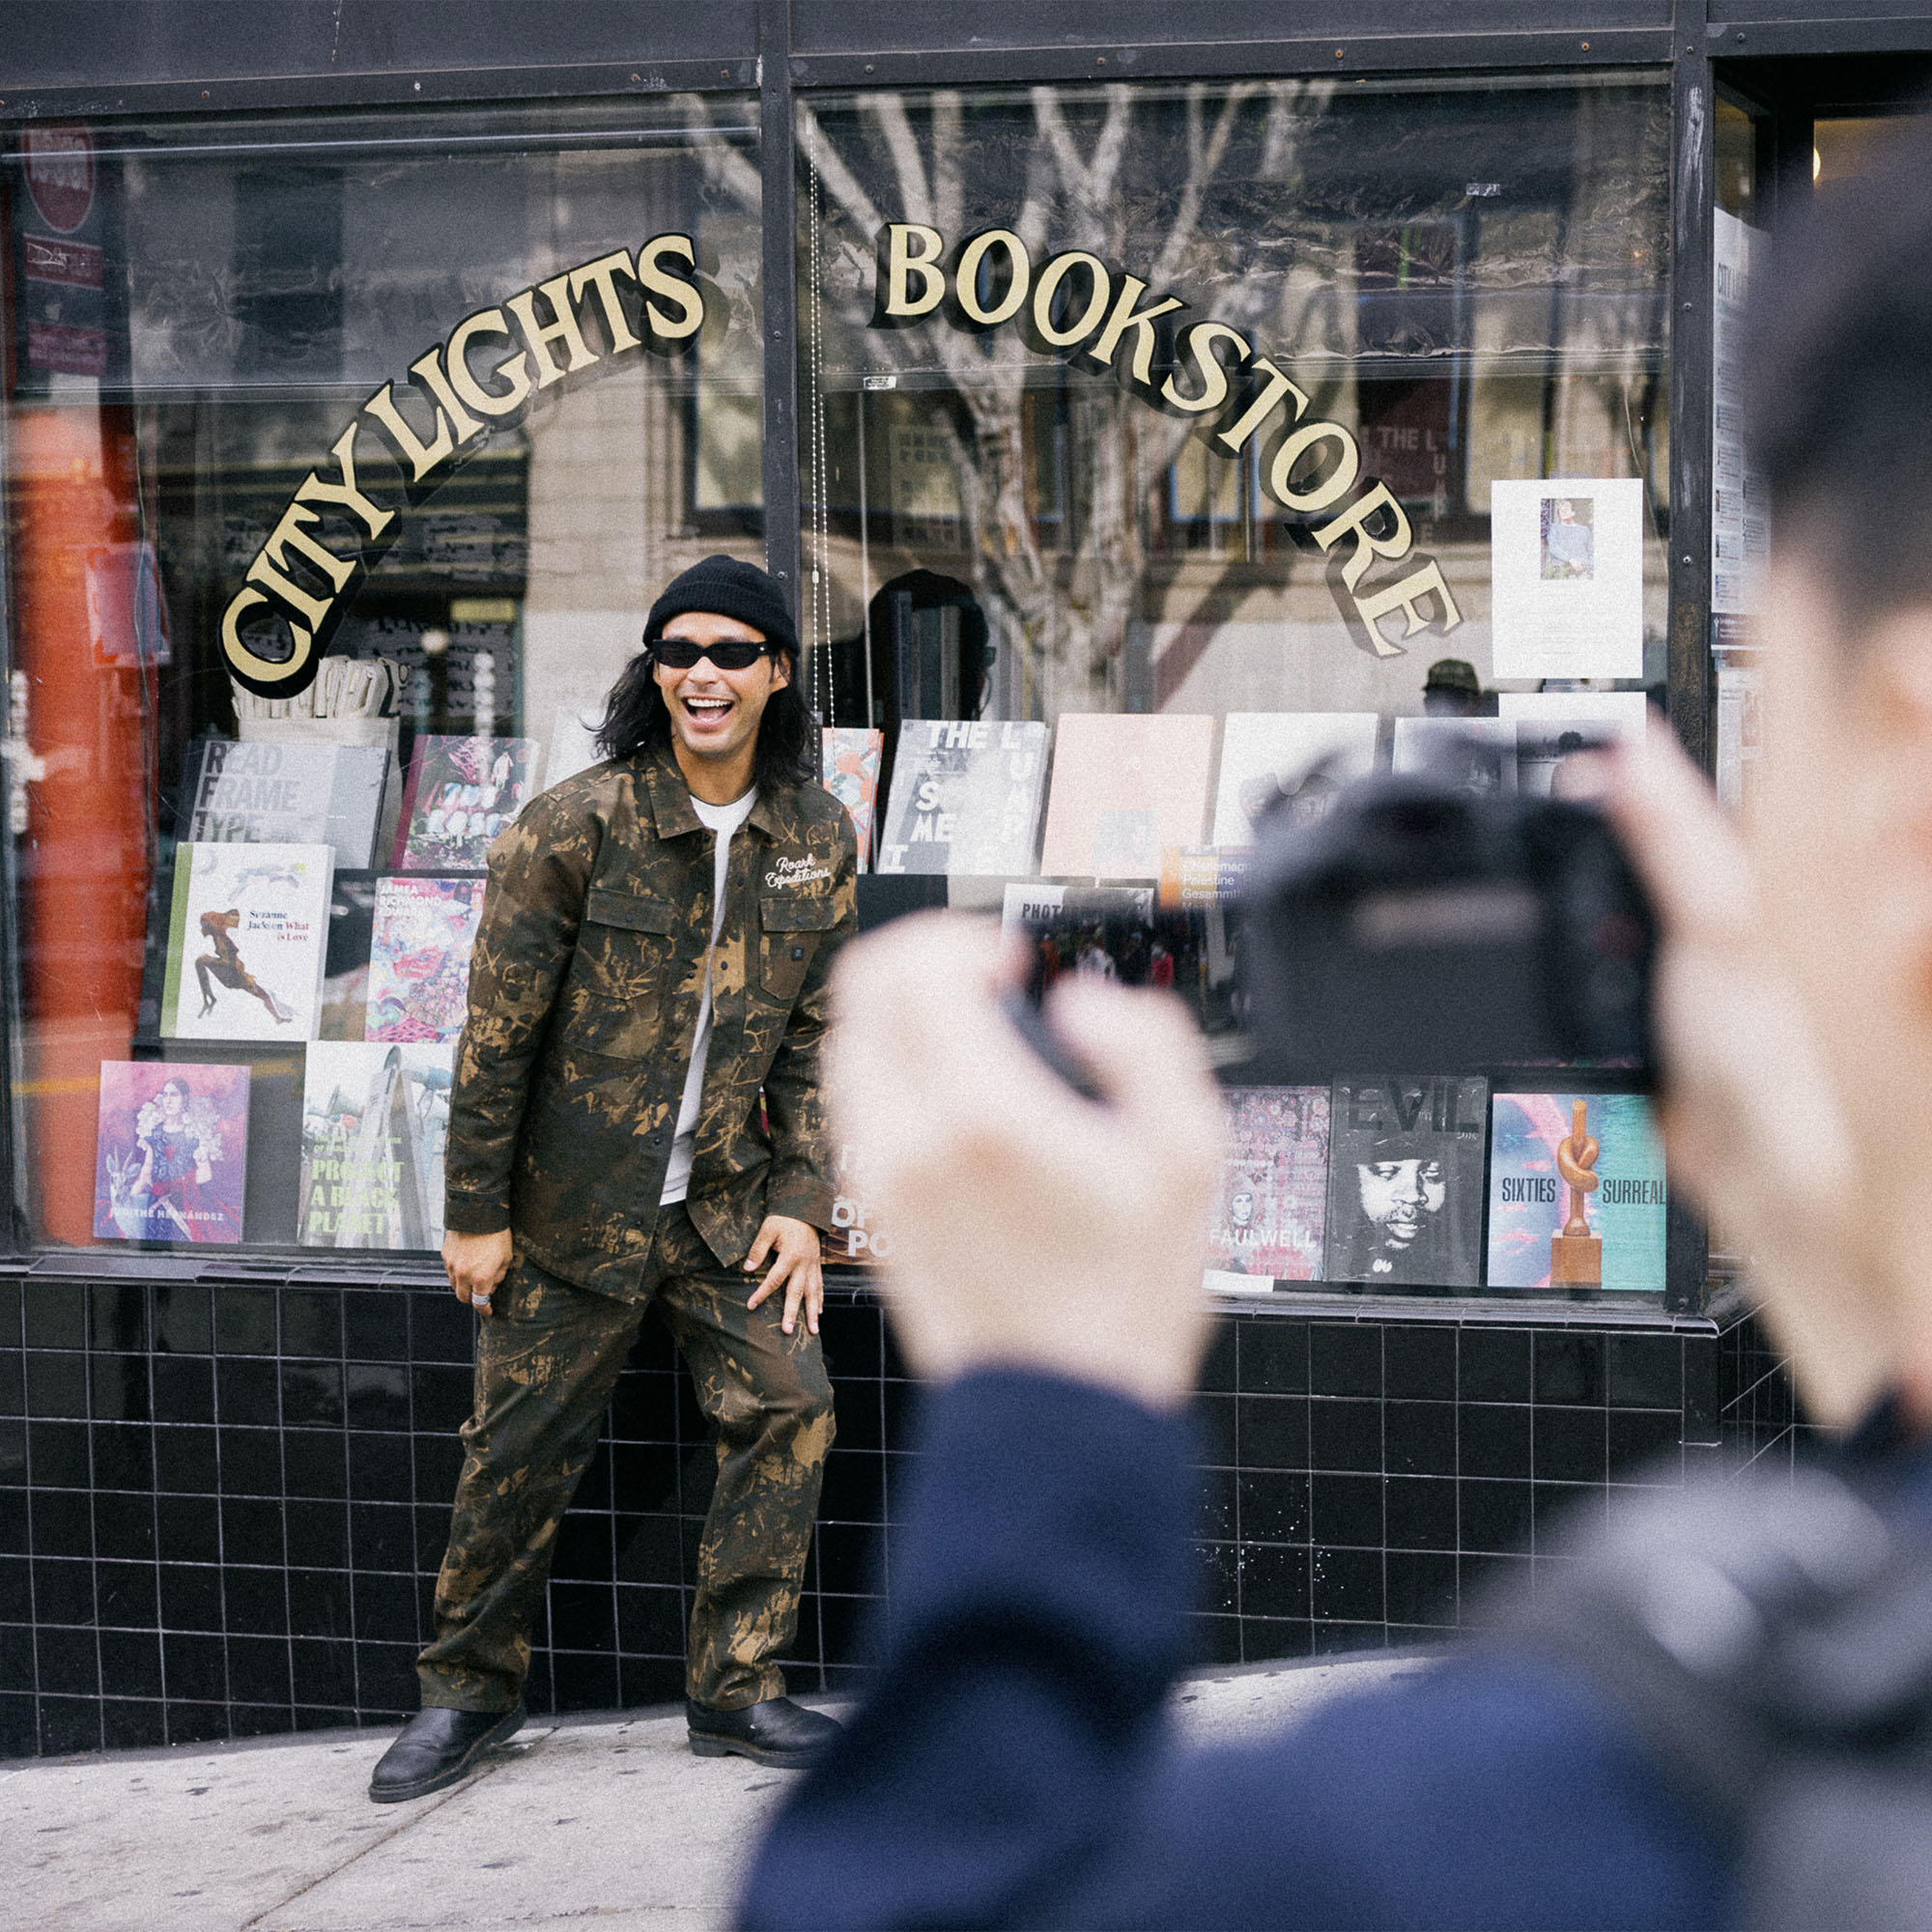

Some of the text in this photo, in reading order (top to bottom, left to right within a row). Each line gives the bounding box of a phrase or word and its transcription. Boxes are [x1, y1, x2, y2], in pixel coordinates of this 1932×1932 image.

[222, 235, 704, 682] CITY LIGHTS
[926, 721, 990, 750] THE
[776, 852, 816, 873] Roark
[765, 867, 832, 890] Expeditions
[247, 921, 309, 931] Jackson What
[249, 911, 288, 920] Suzanne
[276, 932, 285, 941] is
[1349, 1080, 1479, 1132] EVIL
[311, 1159, 405, 1183] PROJECT
[310, 1184, 398, 1208] A BLACK
[1502, 1177, 1556, 1204] SIXTIES
[1602, 1179, 1666, 1206] SURREAL
[308, 1210, 386, 1235] PLANET
